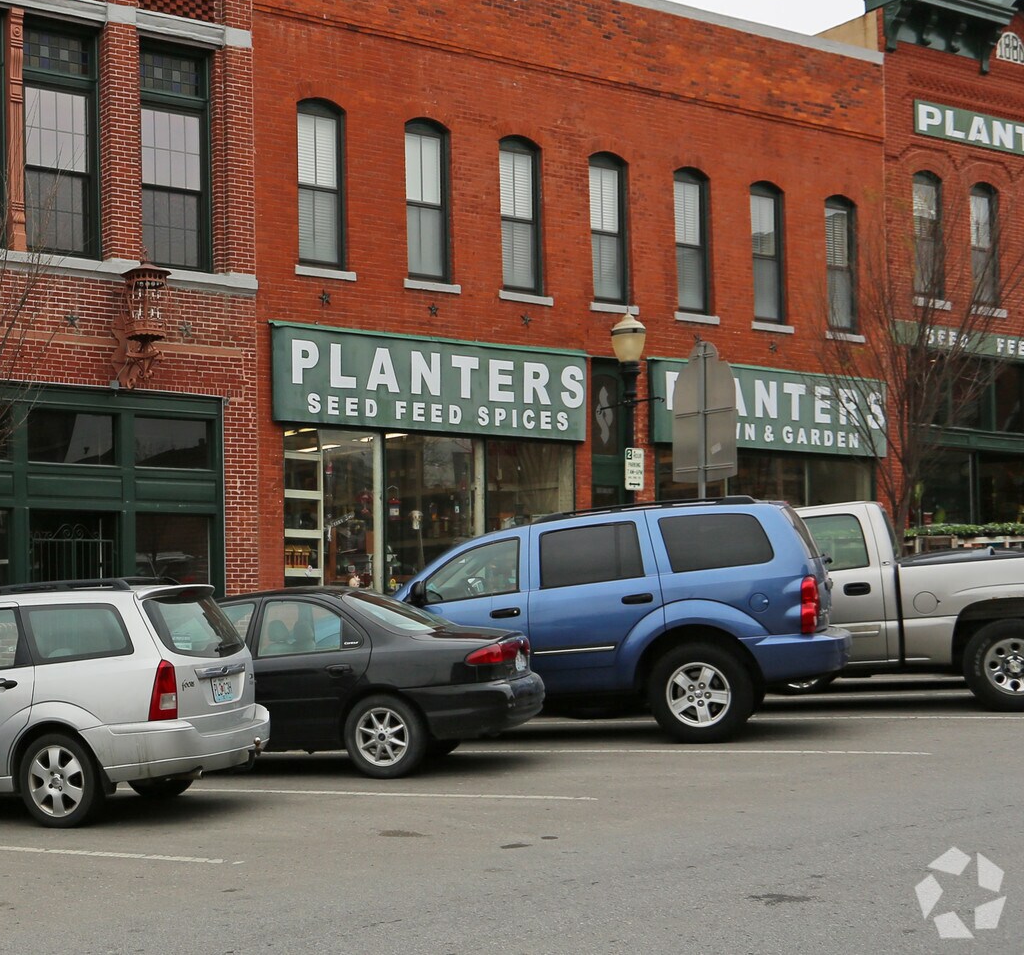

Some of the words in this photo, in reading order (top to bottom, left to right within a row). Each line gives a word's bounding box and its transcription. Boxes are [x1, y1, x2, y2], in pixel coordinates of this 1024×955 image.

[291, 339, 585, 409] PLANTERS
[307, 392, 378, 418] SEED
[395, 400, 463, 425] FEED
[477, 406, 570, 431] SPICES
[665, 371, 885, 430] ANTERS
[627, 449, 632, 459] 2
[764, 424, 775, 442] &
[782, 425, 859, 448] GARDEN
